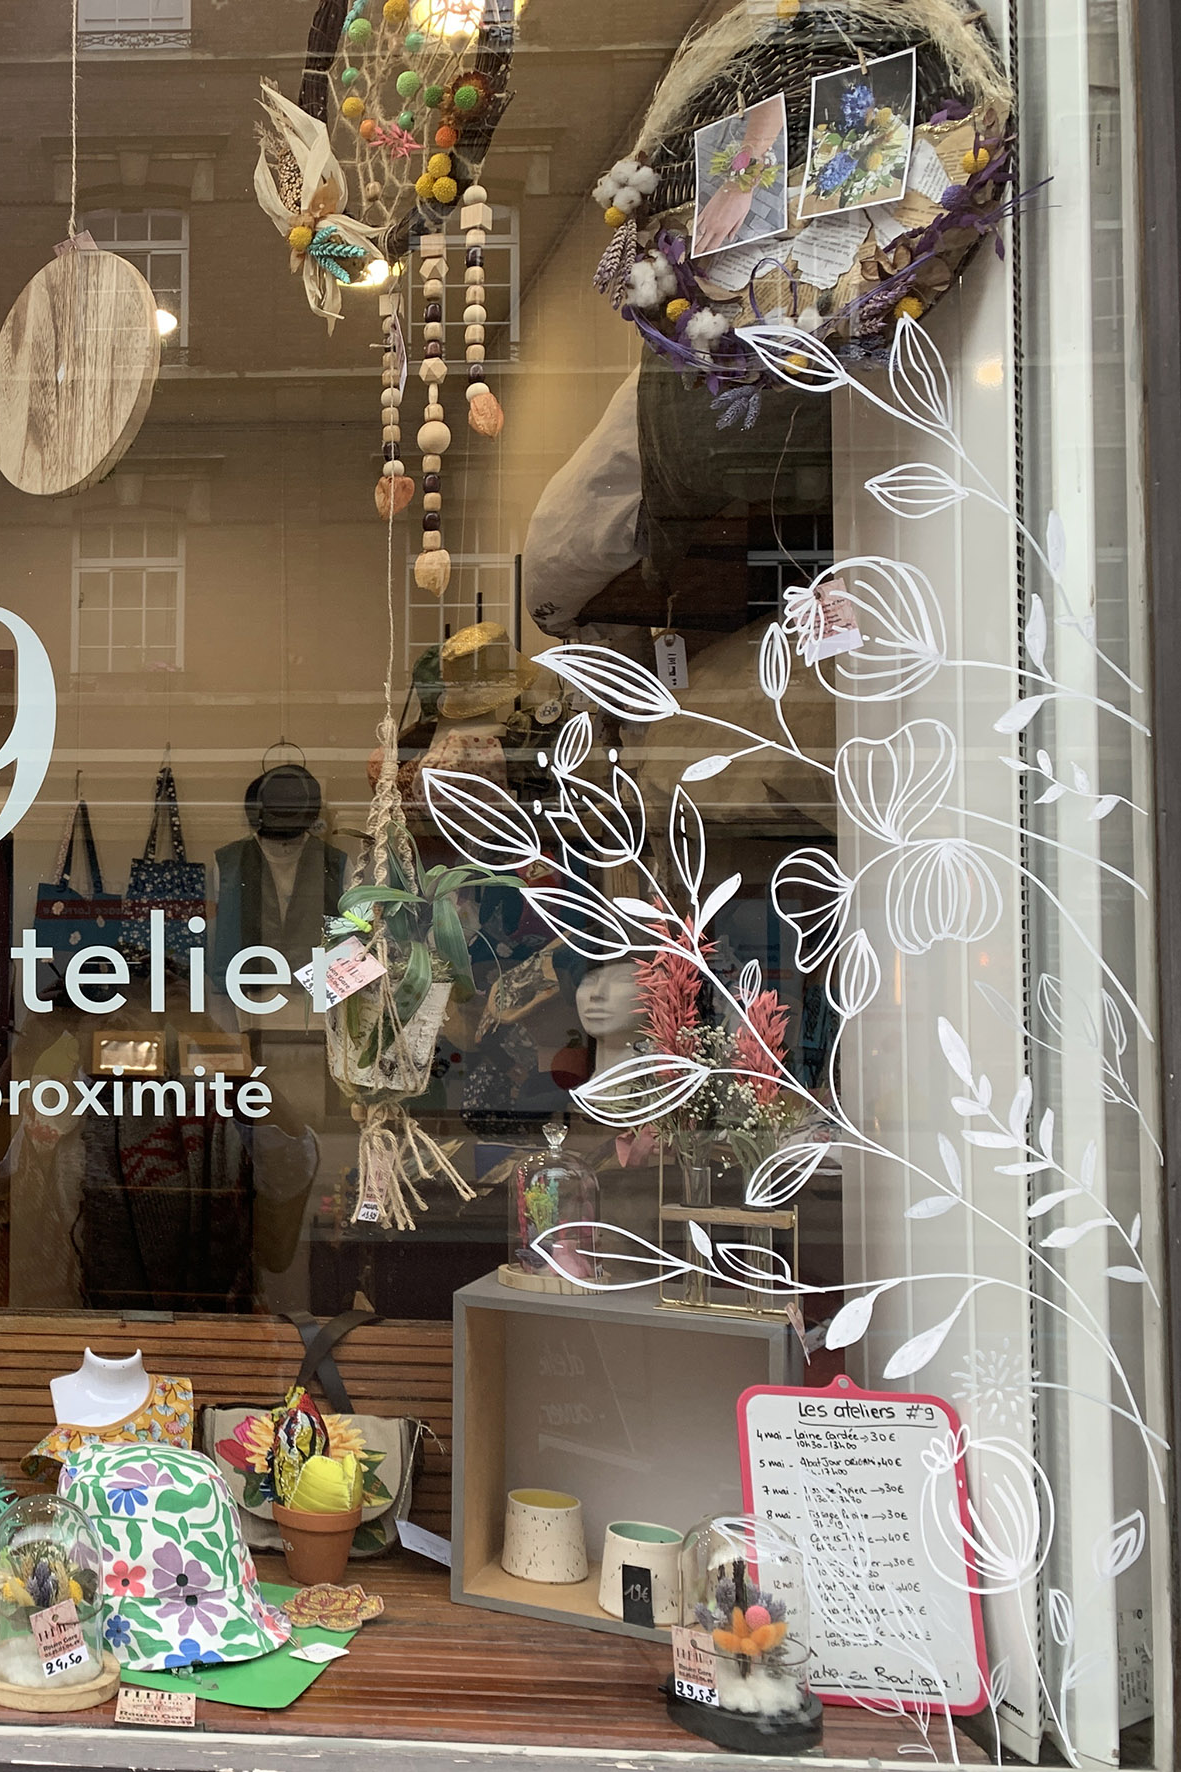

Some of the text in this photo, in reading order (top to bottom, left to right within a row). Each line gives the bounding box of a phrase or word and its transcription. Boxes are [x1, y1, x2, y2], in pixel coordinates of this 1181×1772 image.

[798, 1401, 935, 1421] Les ateliers #9
[756, 1429, 764, 1442] 4
[764, 1431, 782, 1441] mai
[759, 1460, 766, 1468] 5
[768, 1460, 786, 1469] mai
[762, 1486, 770, 1496] 7
[766, 1509, 774, 1520] 8
[775, 1511, 792, 1520] mai
[624, 1583, 650, 1604] 19€
[45, 1652, 83, 1676] 29,50
